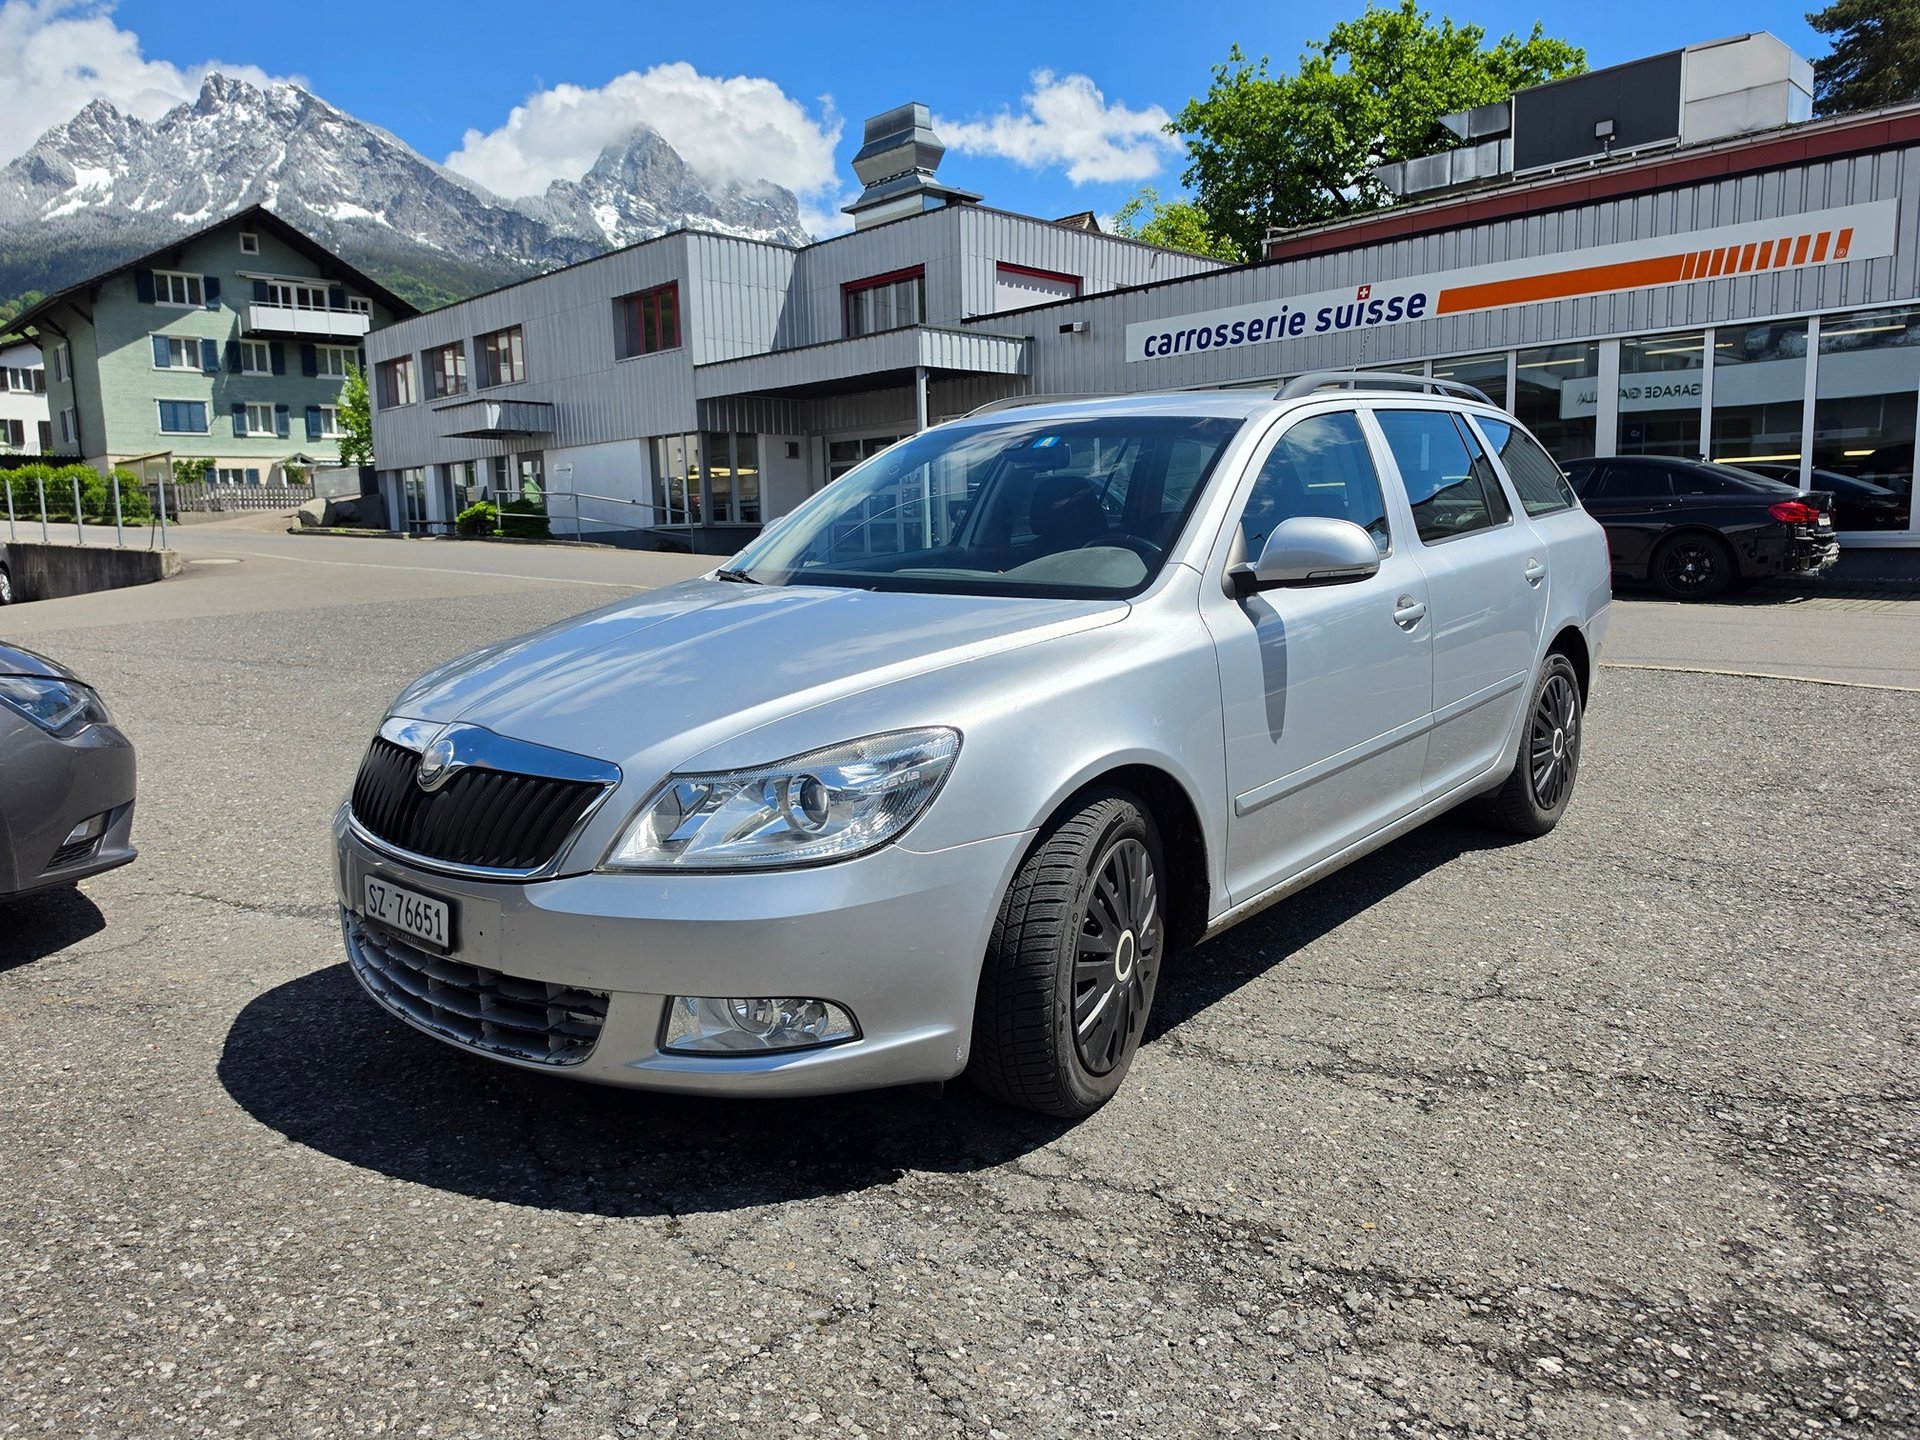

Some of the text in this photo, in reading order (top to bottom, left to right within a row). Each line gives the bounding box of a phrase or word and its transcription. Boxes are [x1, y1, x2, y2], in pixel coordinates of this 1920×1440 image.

[1144, 285, 1427, 357] carrosserie suisse
[369, 884, 443, 941] SZ 76651
